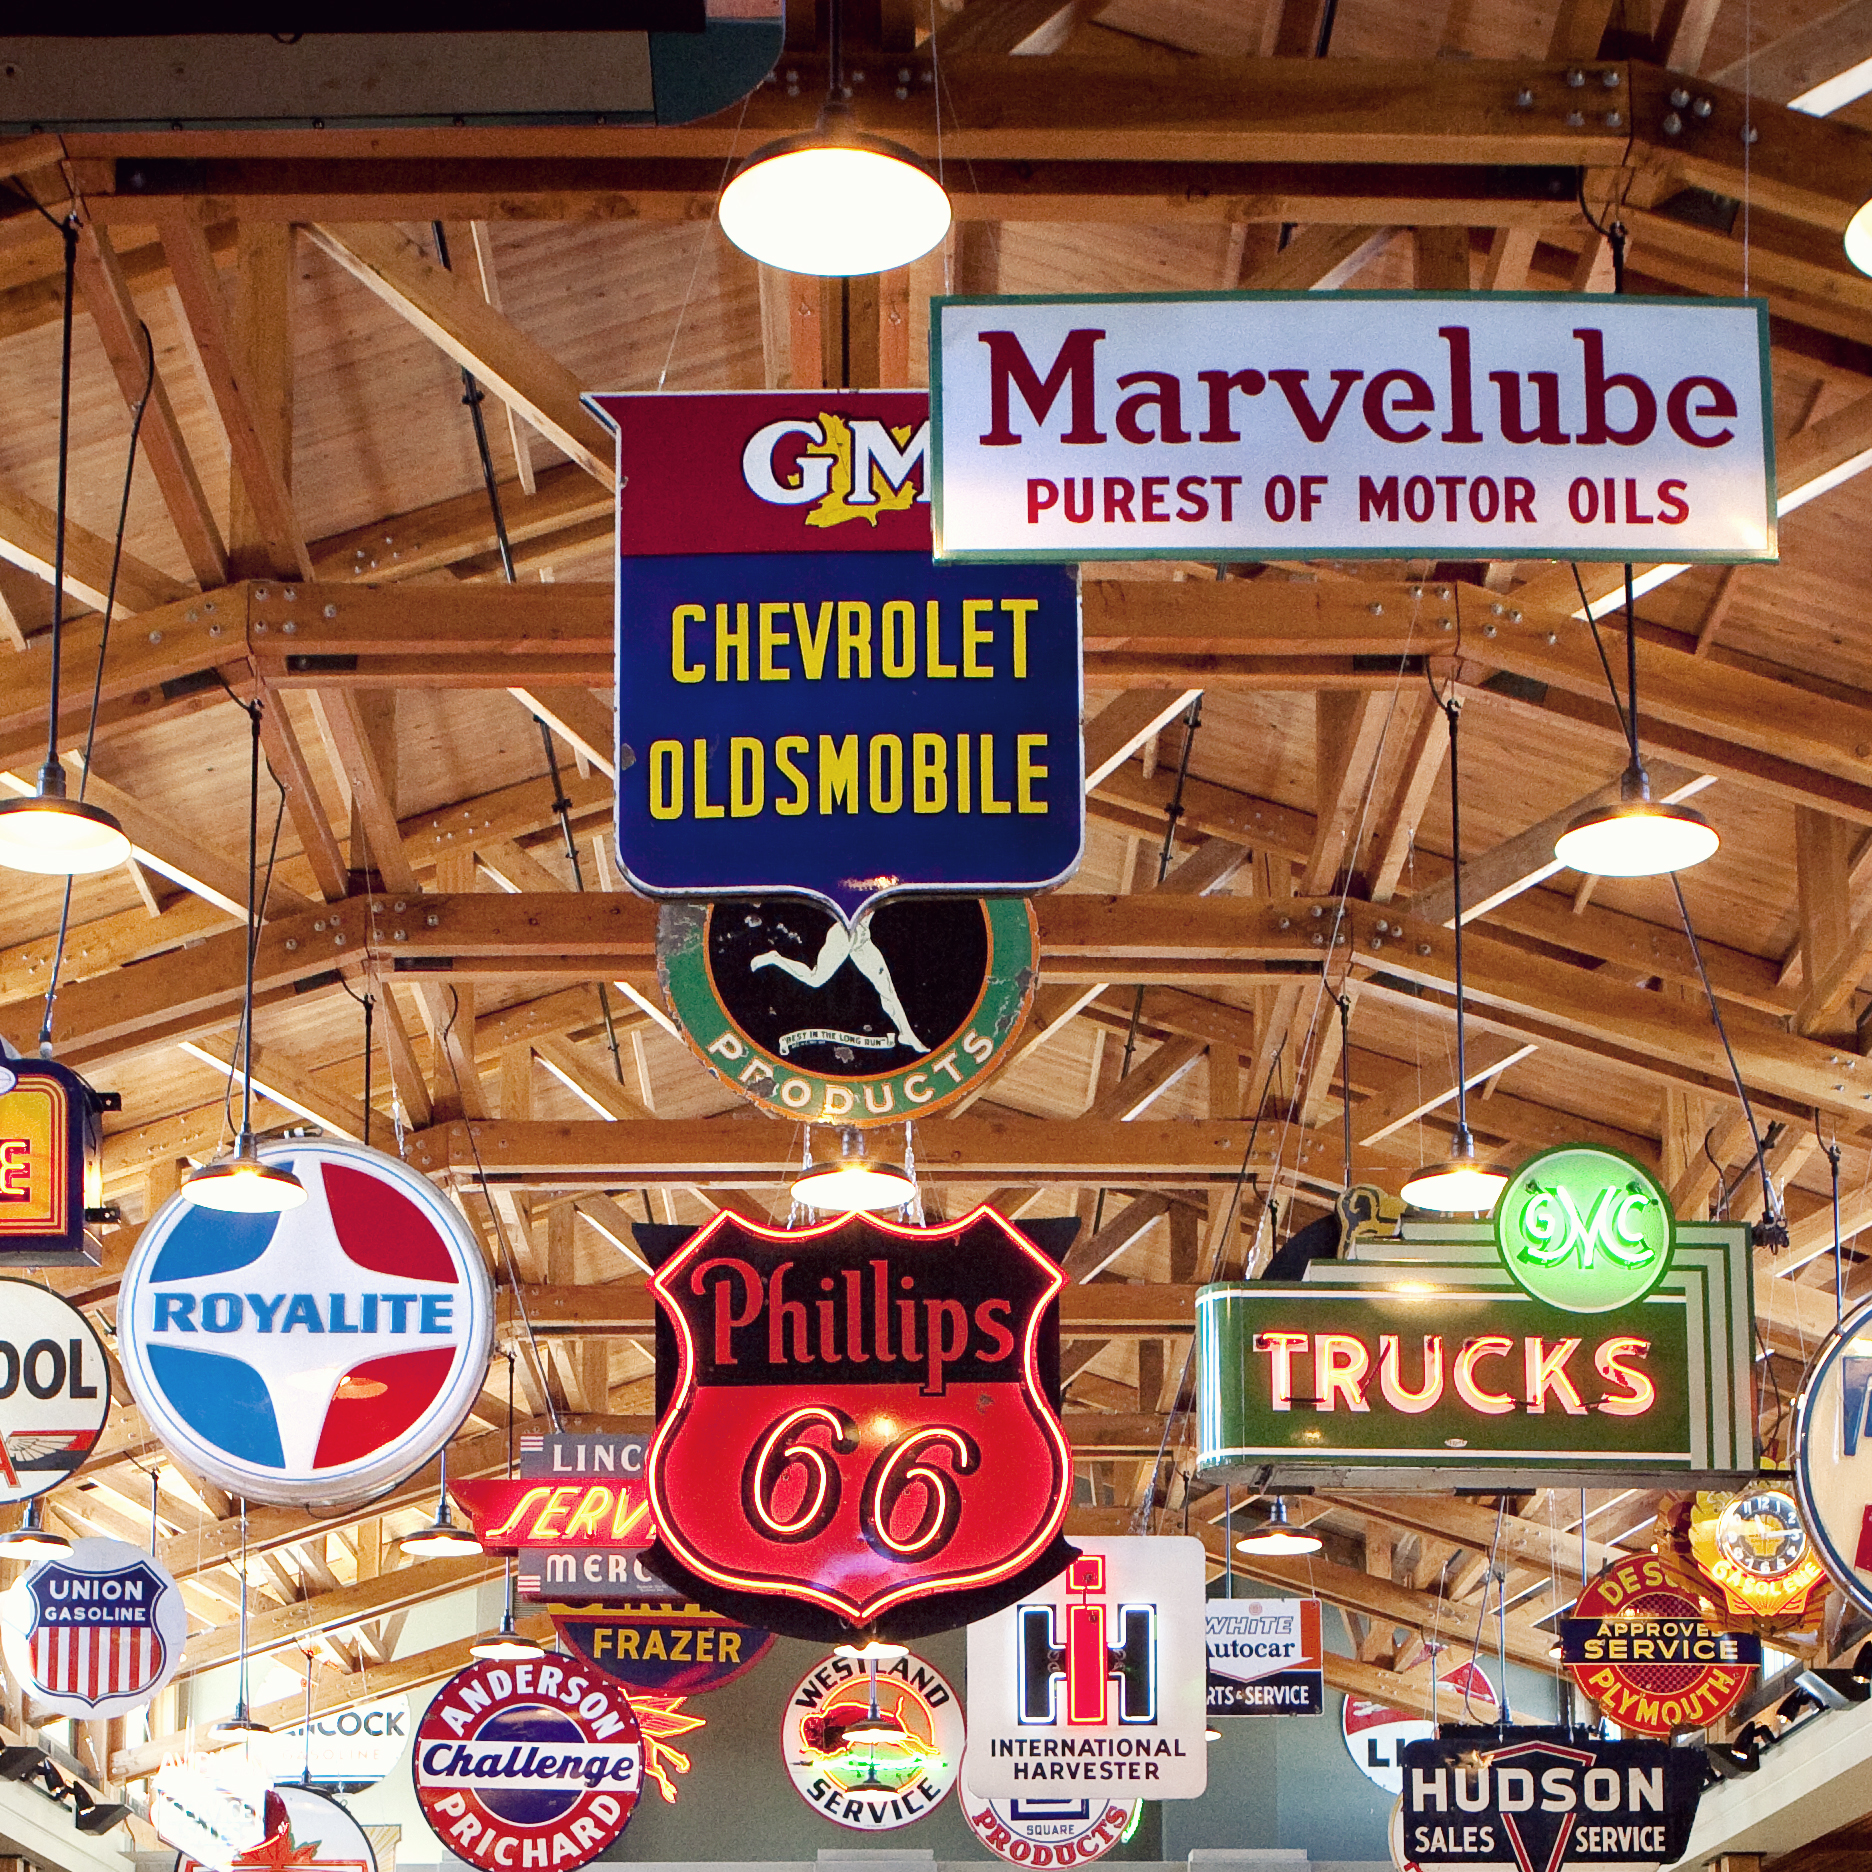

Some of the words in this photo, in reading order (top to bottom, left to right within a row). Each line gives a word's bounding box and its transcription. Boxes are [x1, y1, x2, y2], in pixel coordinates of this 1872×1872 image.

[978, 325, 1740, 450] Marvelube
[1026, 476, 1246, 525] PUREST
[1264, 475, 1328, 524] OF
[1358, 476, 1536, 525] MOTOR
[1566, 475, 1692, 525] OILS
[669, 597, 1040, 685] CHEVROLET
[648, 732, 1052, 822] OLDSMOBILE
[839, 1032, 862, 1045] LONG
[708, 1027, 995, 1117] PRODUCTS
[1515, 1184, 1656, 1270] GMC
[152, 1291, 455, 1334] ROYALITE
[689, 1256, 1017, 1395] Phillips
[1252, 1331, 1657, 1417] TRUCKS
[740, 1402, 981, 1563] 66
[48, 1578, 144, 1602] UNION
[1596, 1561, 1678, 1607] DES
[1711, 1559, 1823, 1597] GASOLENE
[43, 1604, 147, 1624] GASOLINE
[593, 1627, 744, 1664] FRAZER
[1584, 1639, 1739, 1660] SERVICE
[439, 1664, 626, 1740] ANDERSON
[1244, 1684, 1310, 1706] SERVICE
[1588, 1667, 1736, 1727] PLYMOUTH
[422, 1742, 635, 1788] Challenge
[990, 1737, 1188, 1758] INTERNATIONAL
[1013, 1760, 1161, 1781] HARVESTER
[806, 1776, 942, 1826] SERVICE
[1410, 1766, 1665, 1813] HUDSON
[433, 1791, 622, 1869] PRICHARD
[971, 1804, 1129, 1866] PRODUCTS
[1026, 1824, 1075, 1837] SQUARE
[1414, 1825, 1495, 1854] SALES
[1575, 1824, 1667, 1853] SERVICE
